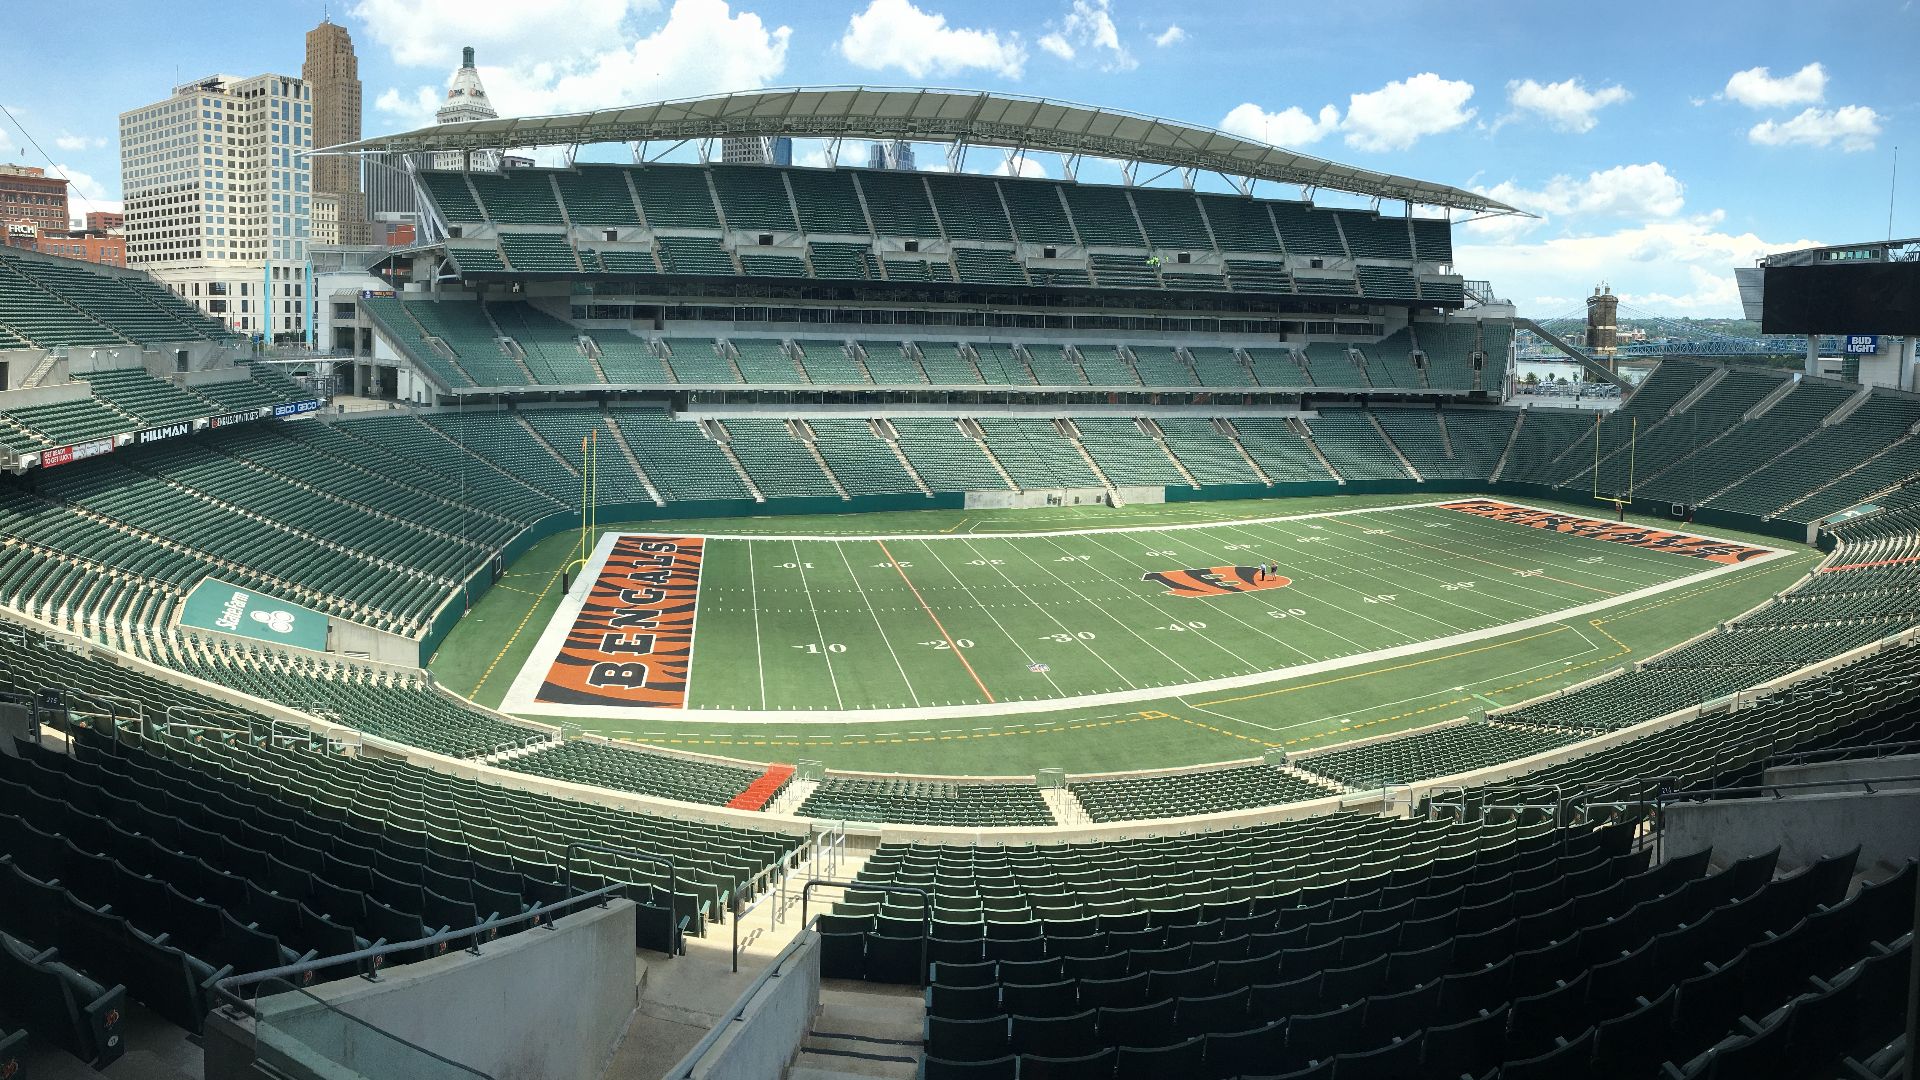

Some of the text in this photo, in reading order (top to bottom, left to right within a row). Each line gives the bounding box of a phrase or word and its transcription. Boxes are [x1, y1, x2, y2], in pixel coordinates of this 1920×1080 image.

[8, 224, 35, 233] FRCH
[1851, 336, 1872, 345] BUD
[1847, 344, 1876, 353] LIGHT
[275, 401, 317, 416] GEICO GEICO
[140, 424, 188, 443] HILLMAN
[1364, 593, 1396, 604] 40
[583, 541, 678, 690] BENGALS
[1266, 608, 1306, 619] 50
[1169, 621, 1207, 632] 40
[1051, 631, 1096, 643] 30
[806, 643, 847, 654] 10
[930, 638, 975, 650] 20
